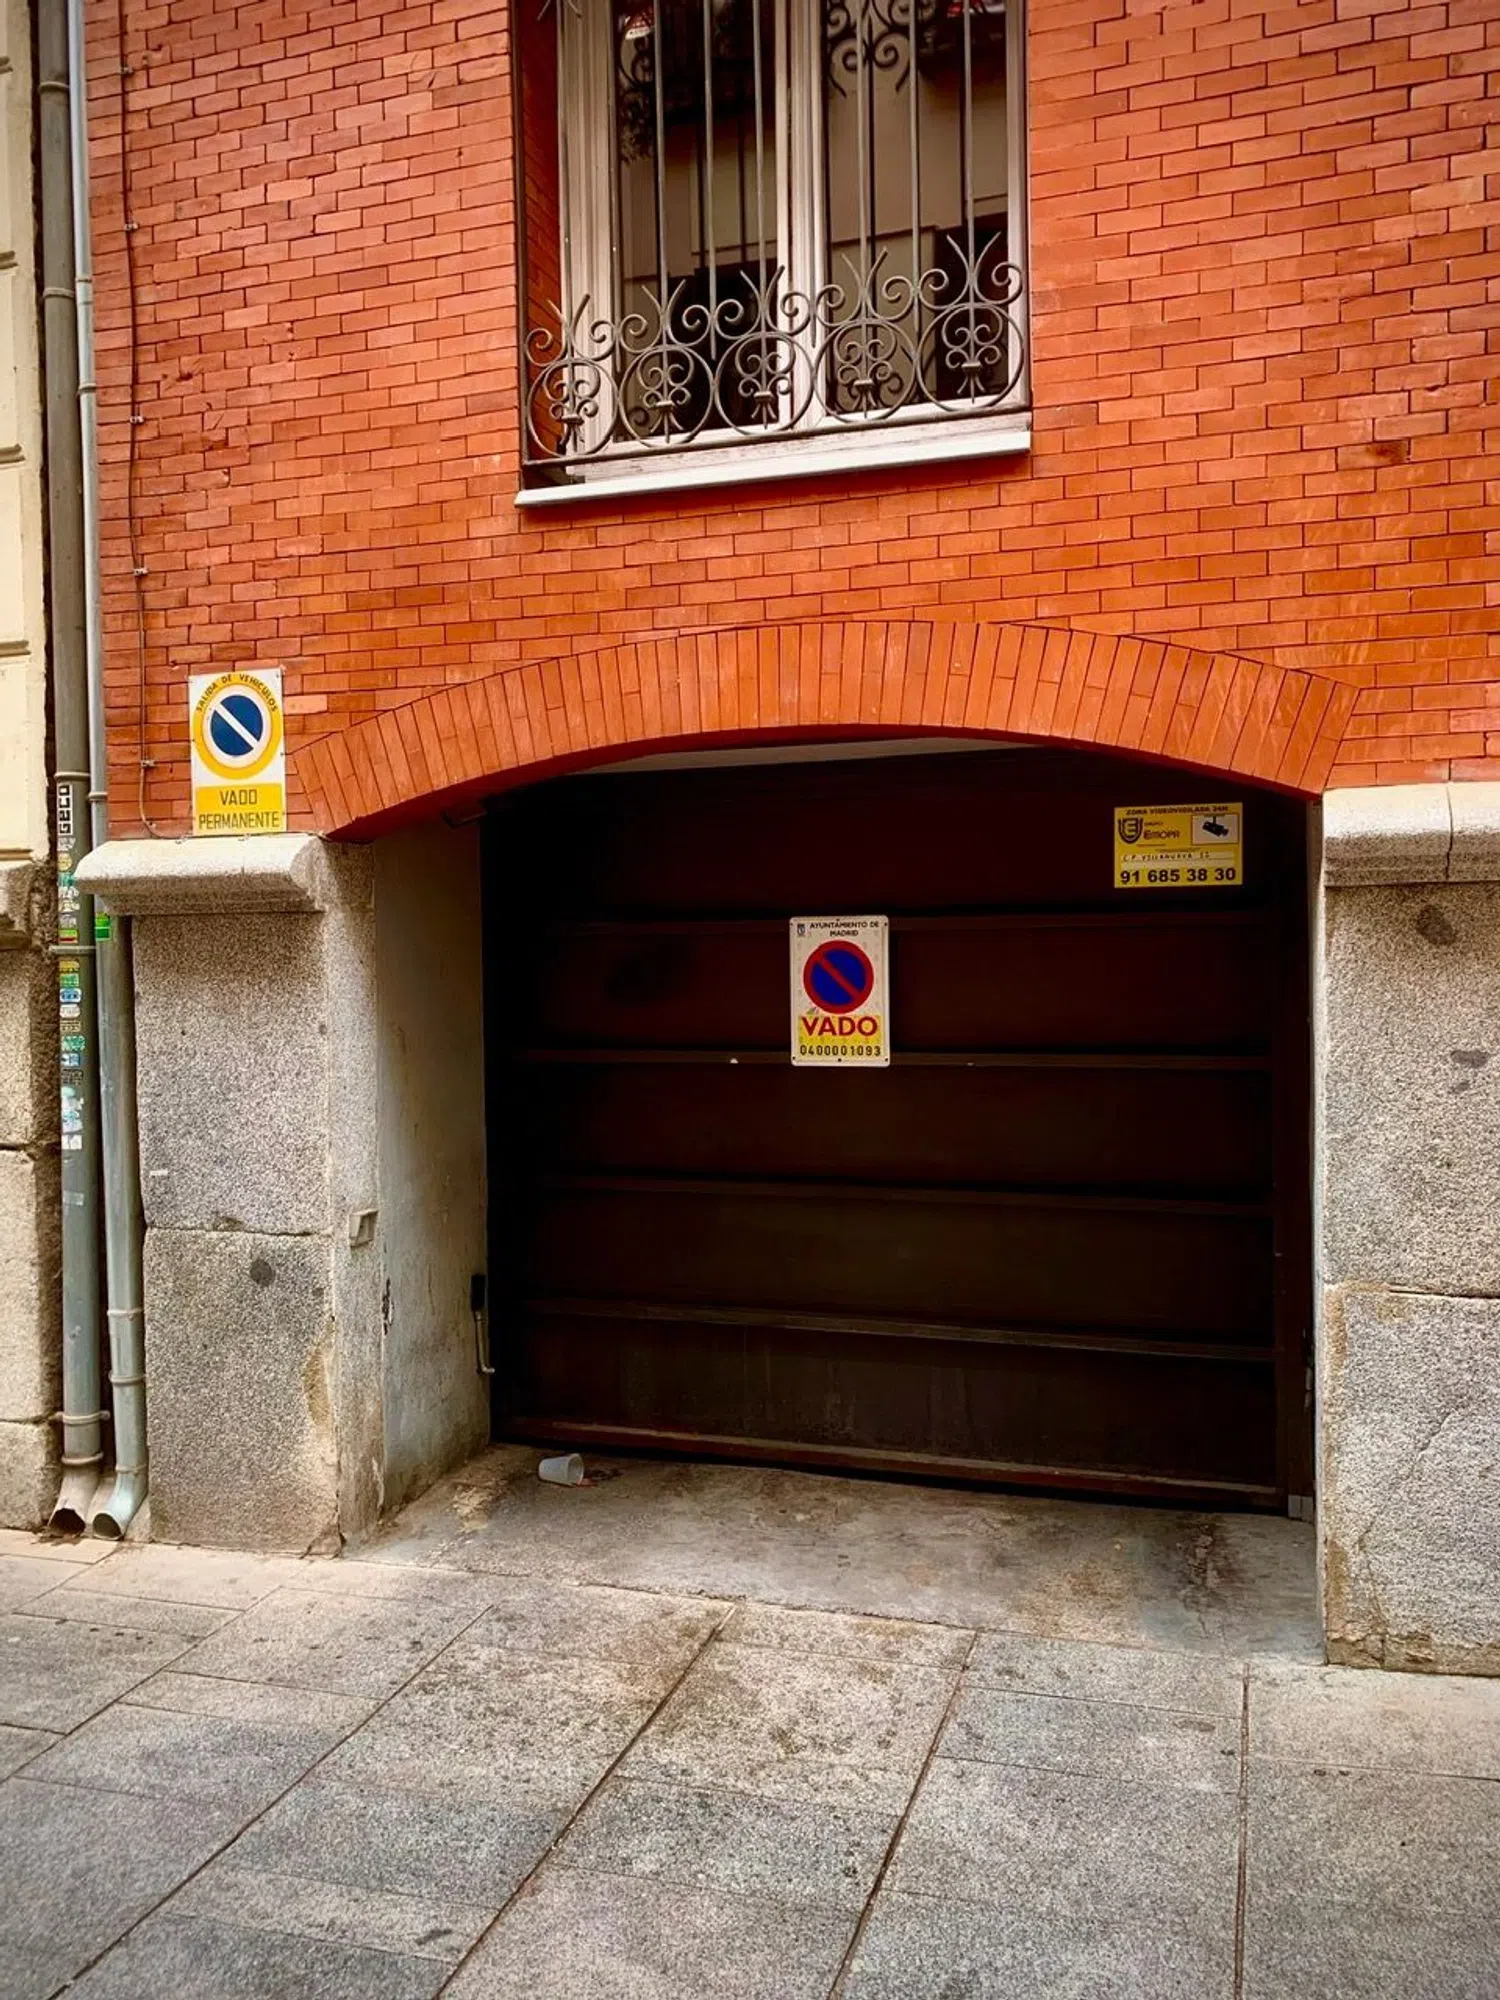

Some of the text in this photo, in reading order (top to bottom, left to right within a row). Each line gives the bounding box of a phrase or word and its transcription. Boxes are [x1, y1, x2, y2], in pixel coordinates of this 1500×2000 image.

[196, 673, 278, 713] SALIDA DE VEHICULOS
[219, 788, 258, 806] VADO
[198, 811, 280, 830] PERMANENTE
[1120, 867, 1236, 885] 91 685 38 30
[809, 920, 879, 930] AYUNTAMIENTO DE
[829, 929, 859, 938] MADRID
[801, 1016, 879, 1037] VADO
[799, 1044, 882, 1057] 0400001093
